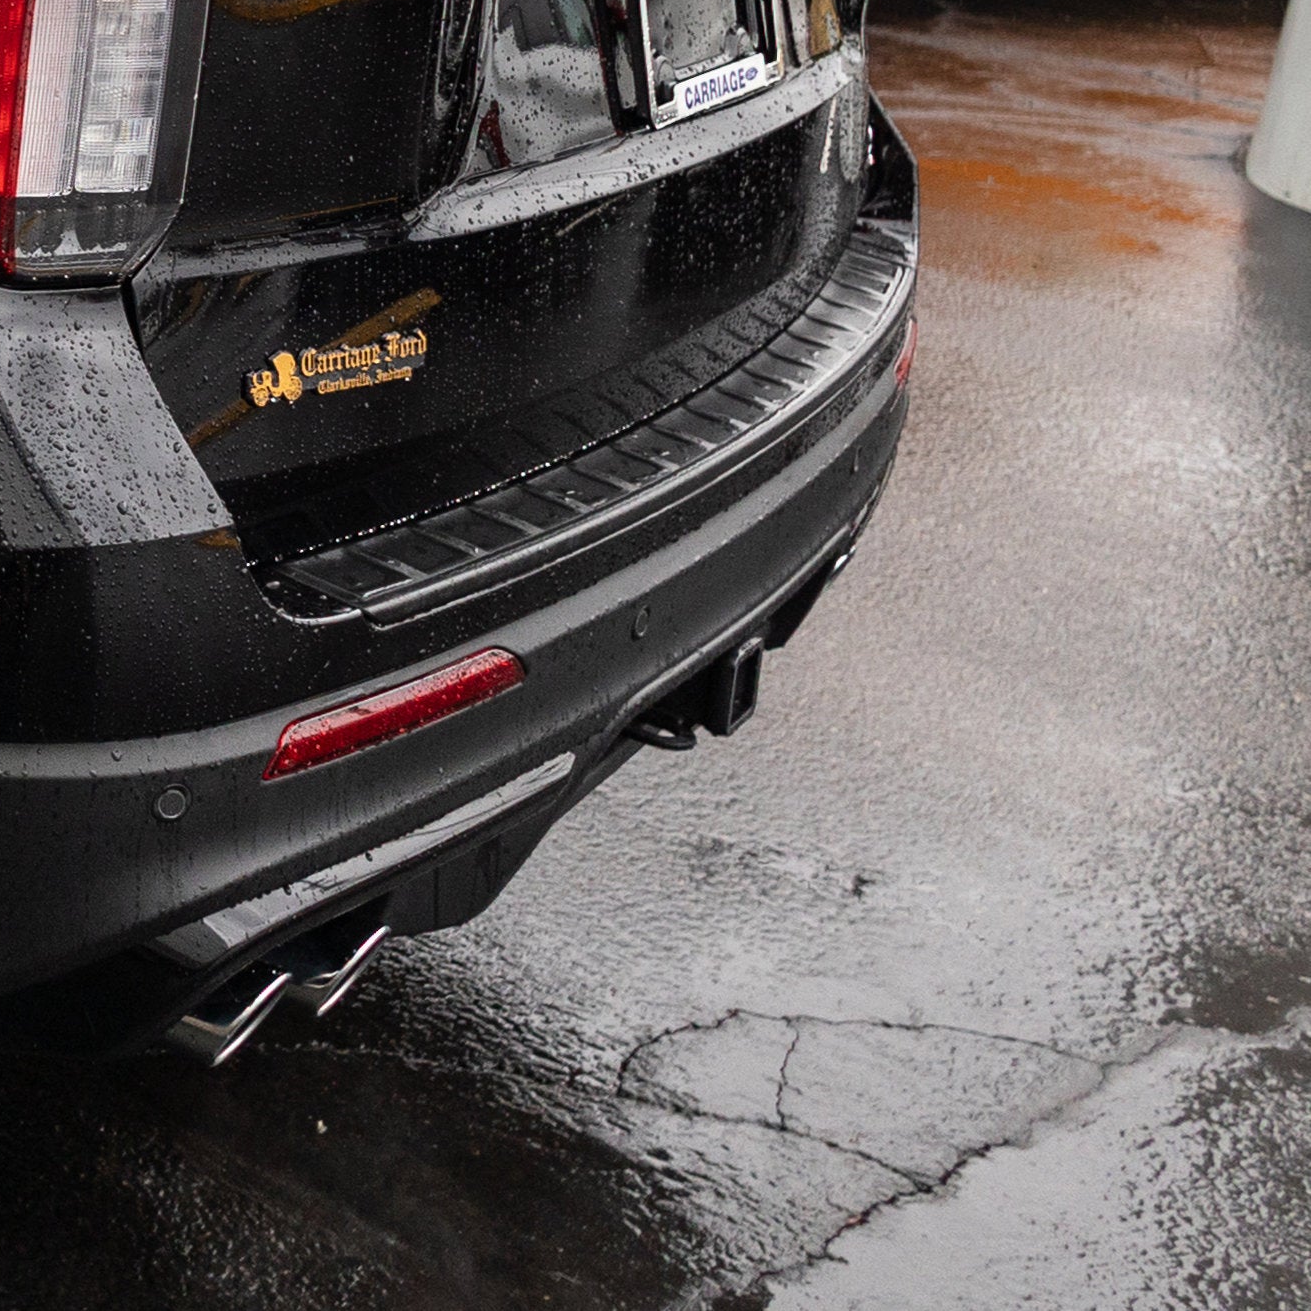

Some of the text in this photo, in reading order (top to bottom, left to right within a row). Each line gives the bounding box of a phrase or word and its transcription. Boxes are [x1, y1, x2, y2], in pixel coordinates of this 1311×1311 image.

[684, 68, 746, 109] CARRIAGE
[300, 328, 427, 377] Carriage Ford
